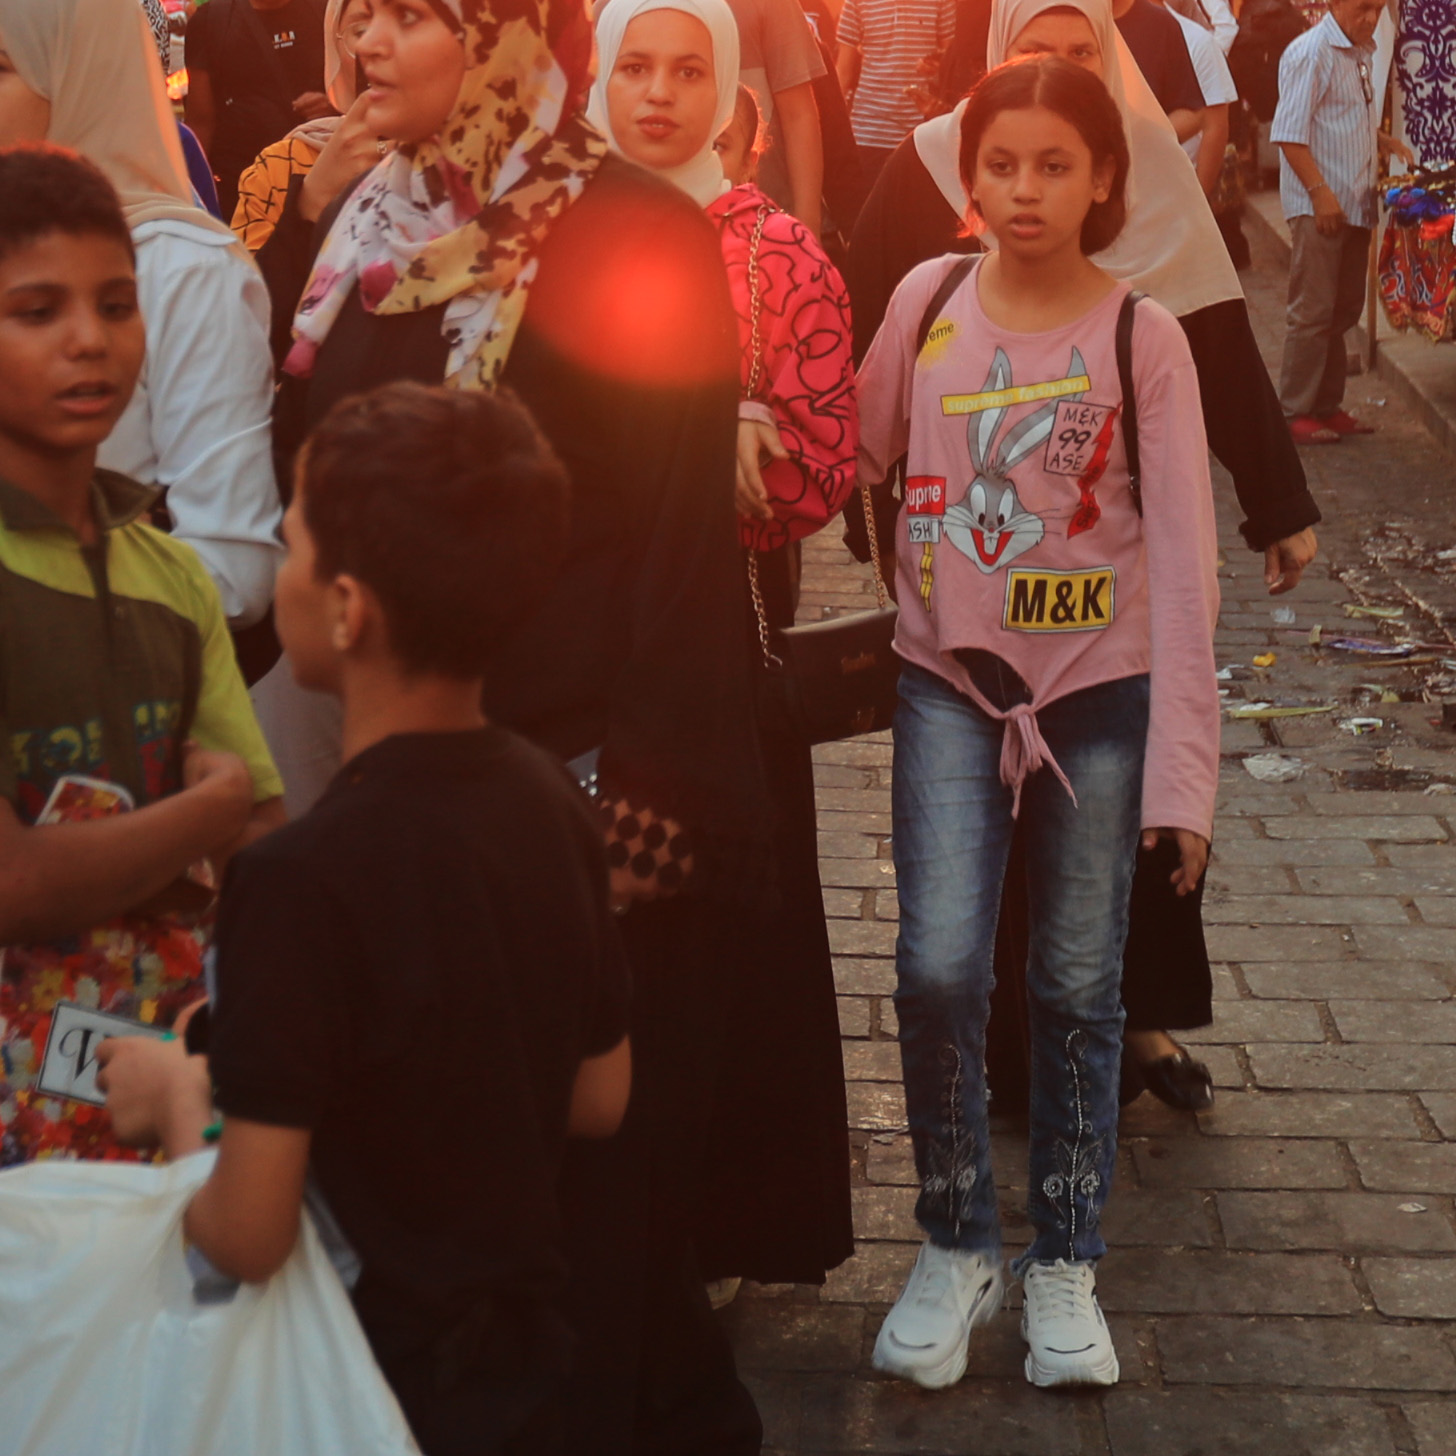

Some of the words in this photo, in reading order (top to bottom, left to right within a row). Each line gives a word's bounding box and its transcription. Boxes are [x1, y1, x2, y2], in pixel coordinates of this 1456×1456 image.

[947, 392, 1014, 413] supreme
[1019, 378, 1085, 400] fashion
[1058, 428, 1092, 452] 99
[1011, 576, 1108, 624] M&K
